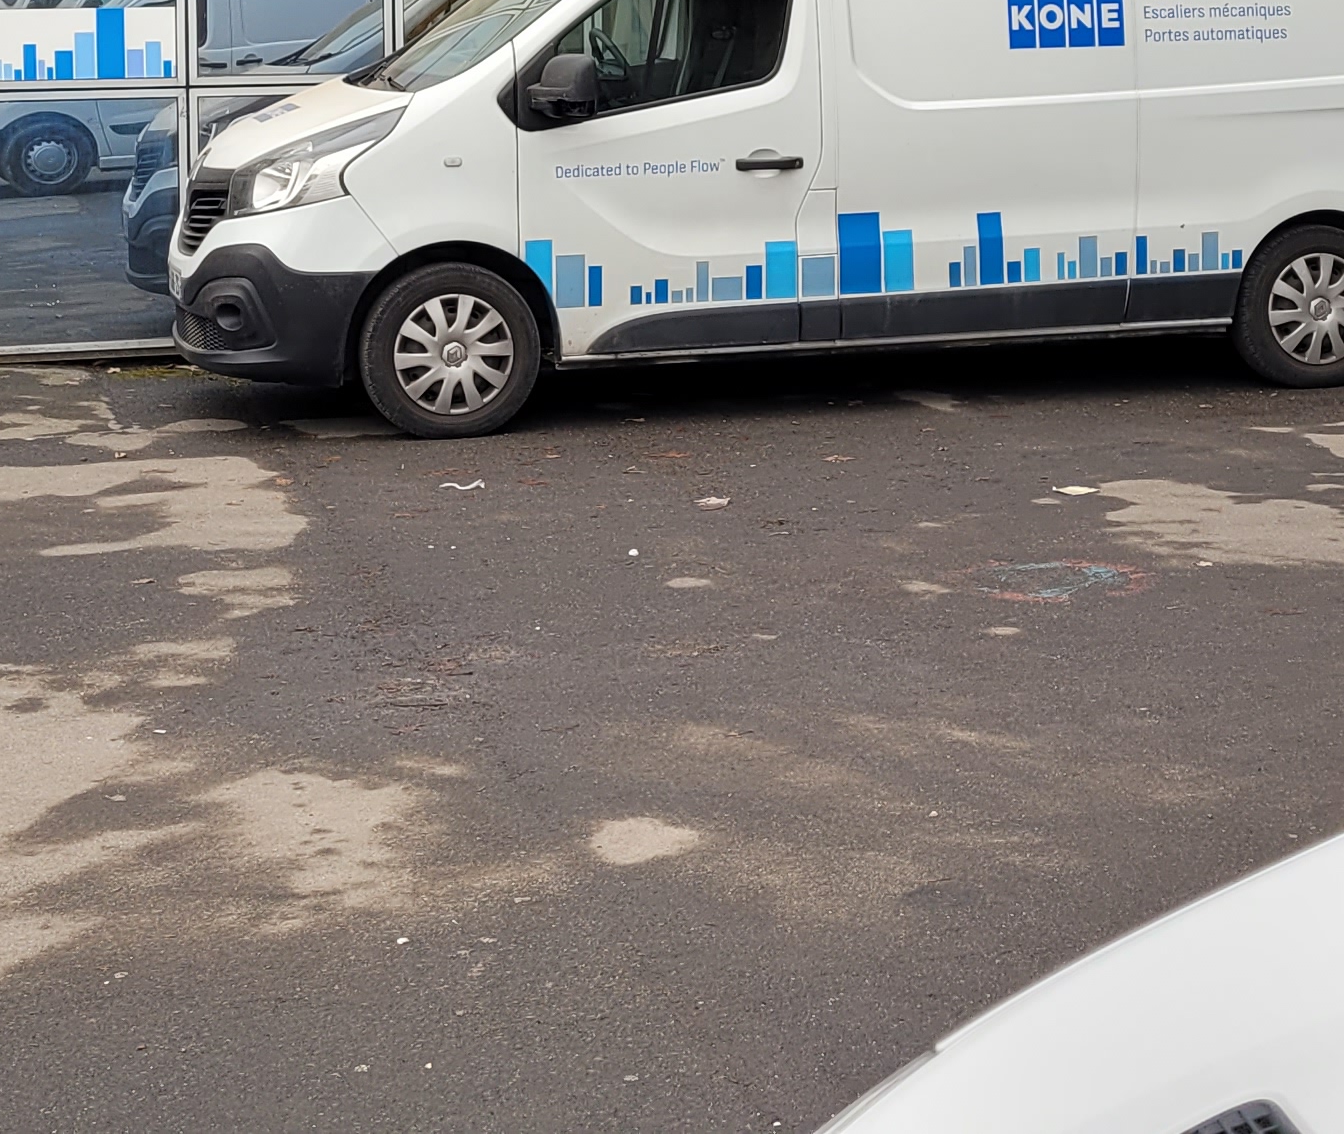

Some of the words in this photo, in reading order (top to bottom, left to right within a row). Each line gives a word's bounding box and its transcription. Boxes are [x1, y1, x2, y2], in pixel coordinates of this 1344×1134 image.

[1010, 2, 1121, 31] KONE
[1143, 5, 1206, 20] Escaliers
[1208, 2, 1292, 21] mécaniques
[1144, 27, 1190, 43] Portes
[1193, 25, 1288, 44] automatiques
[555, 163, 622, 178] Dedicated
[626, 163, 639, 176] to
[643, 160, 687, 177] People
